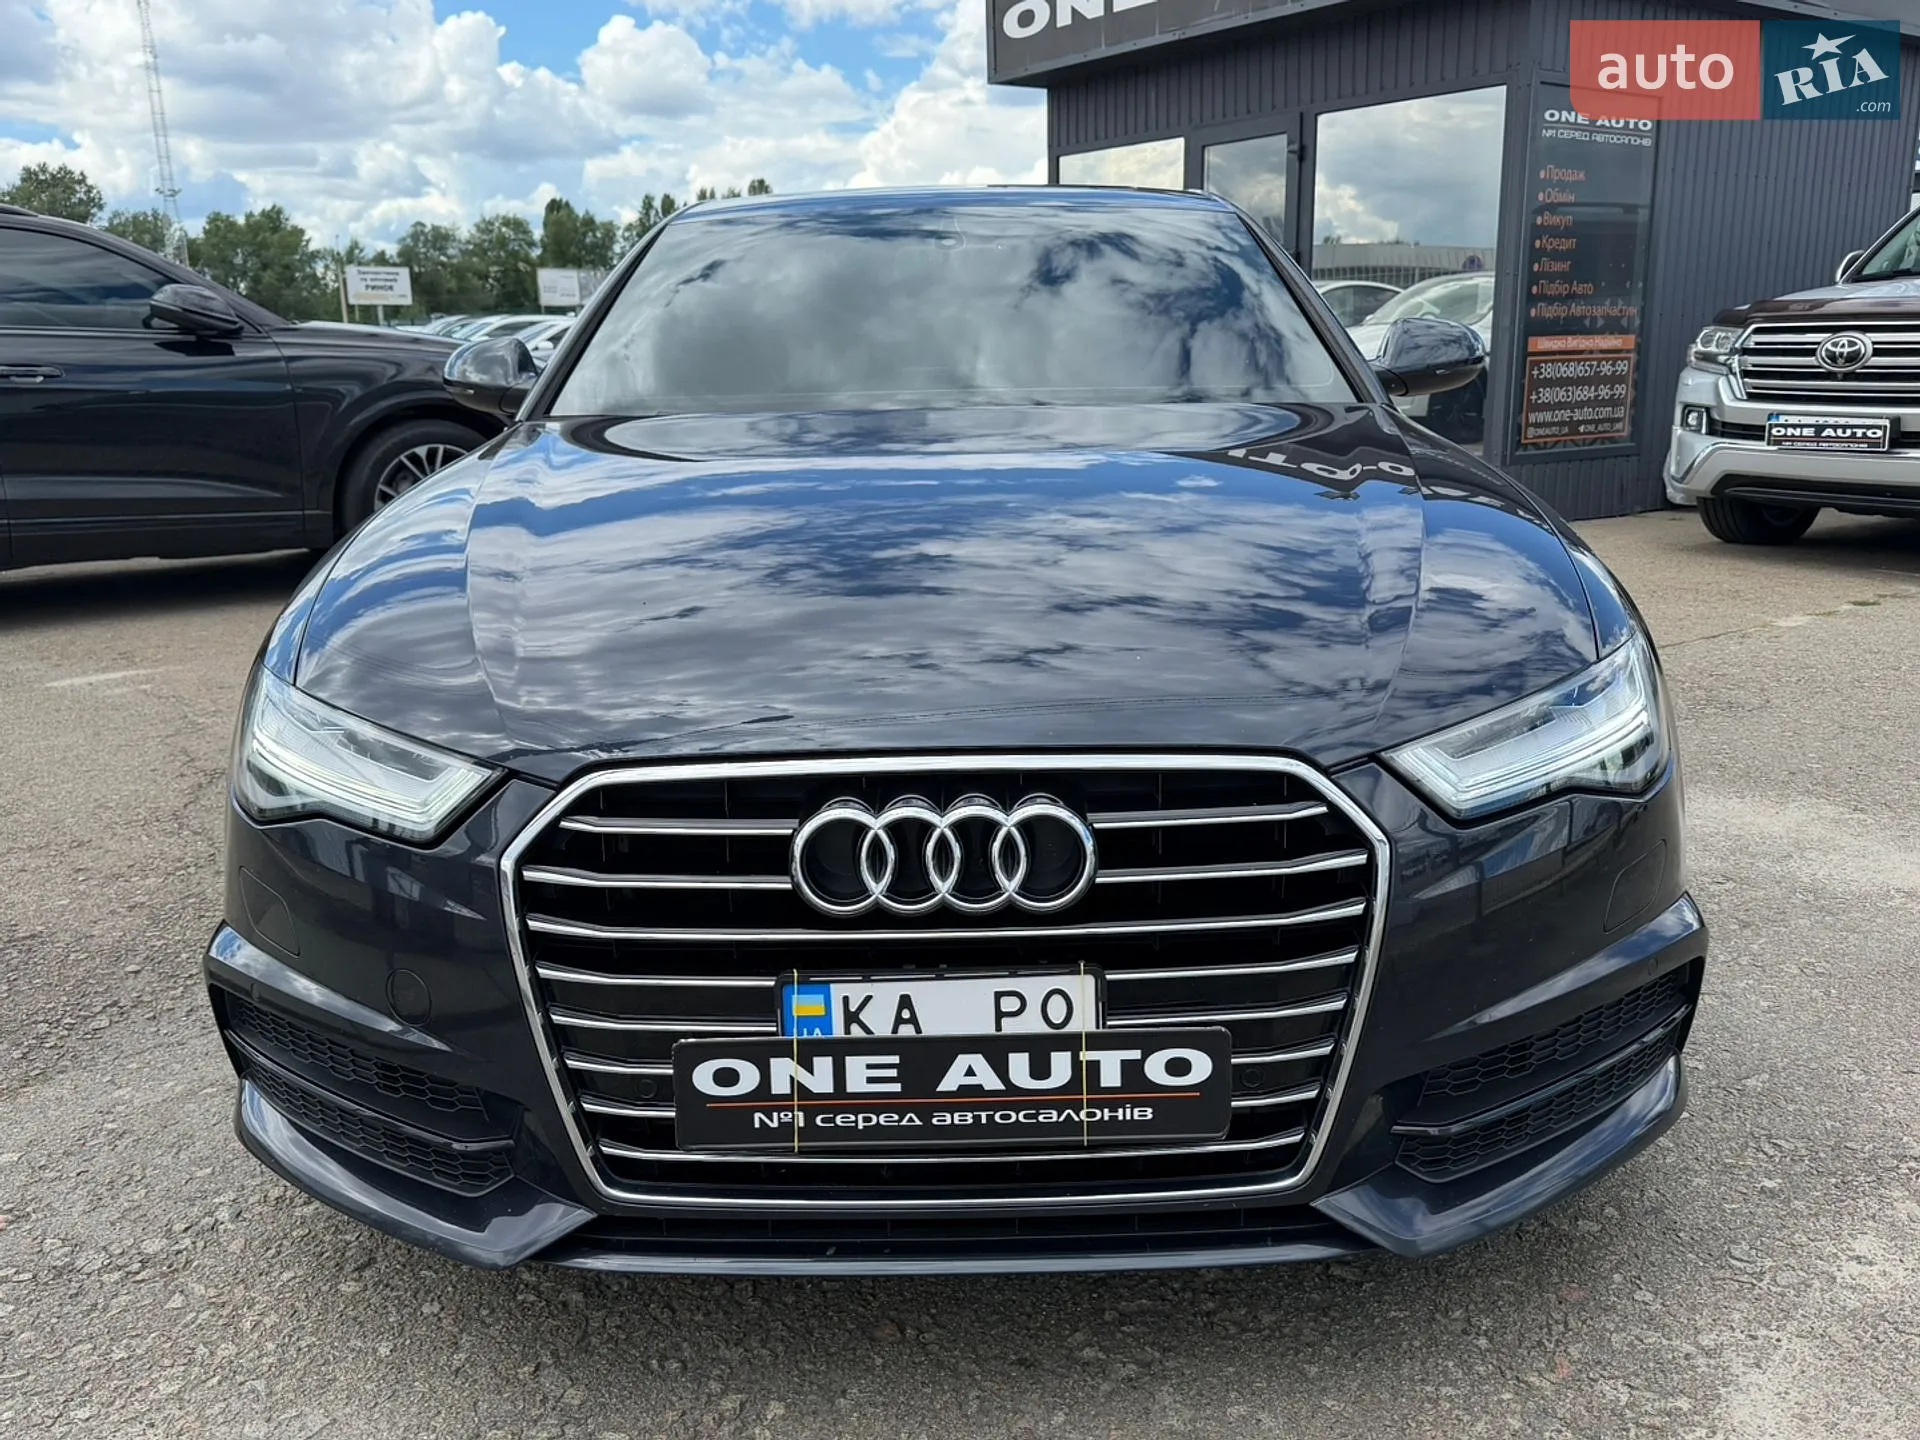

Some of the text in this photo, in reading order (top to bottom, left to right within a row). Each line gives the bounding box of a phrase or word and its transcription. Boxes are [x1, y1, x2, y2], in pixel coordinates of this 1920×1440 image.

[1003, 0, 1158, 38] ON
[1544, 109, 1653, 131] ONE AUTO
[1546, 164, 1586, 183] Продаж
[1545, 187, 1575, 203] Обмін
[1543, 211, 1573, 230] Викуп
[1541, 235, 1577, 252] Кредит
[1539, 257, 1572, 273] Лізинг
[1539, 279, 1594, 297] Підбір Авто
[1537, 301, 1568, 319] Підбір
[1531, 360, 1629, 378] +38(068)657-96-99
[1530, 384, 1626, 404] +38(063)684-96-99
[1528, 406, 1625, 423] www.one-auto.com.ua
[1771, 427, 1883, 438] ONE AUTO
[842, 993, 922, 1035] KA
[692, 1048, 1213, 1096] ONE AUTO
[753, 1104, 1154, 1130] №1 серед автосалонів
